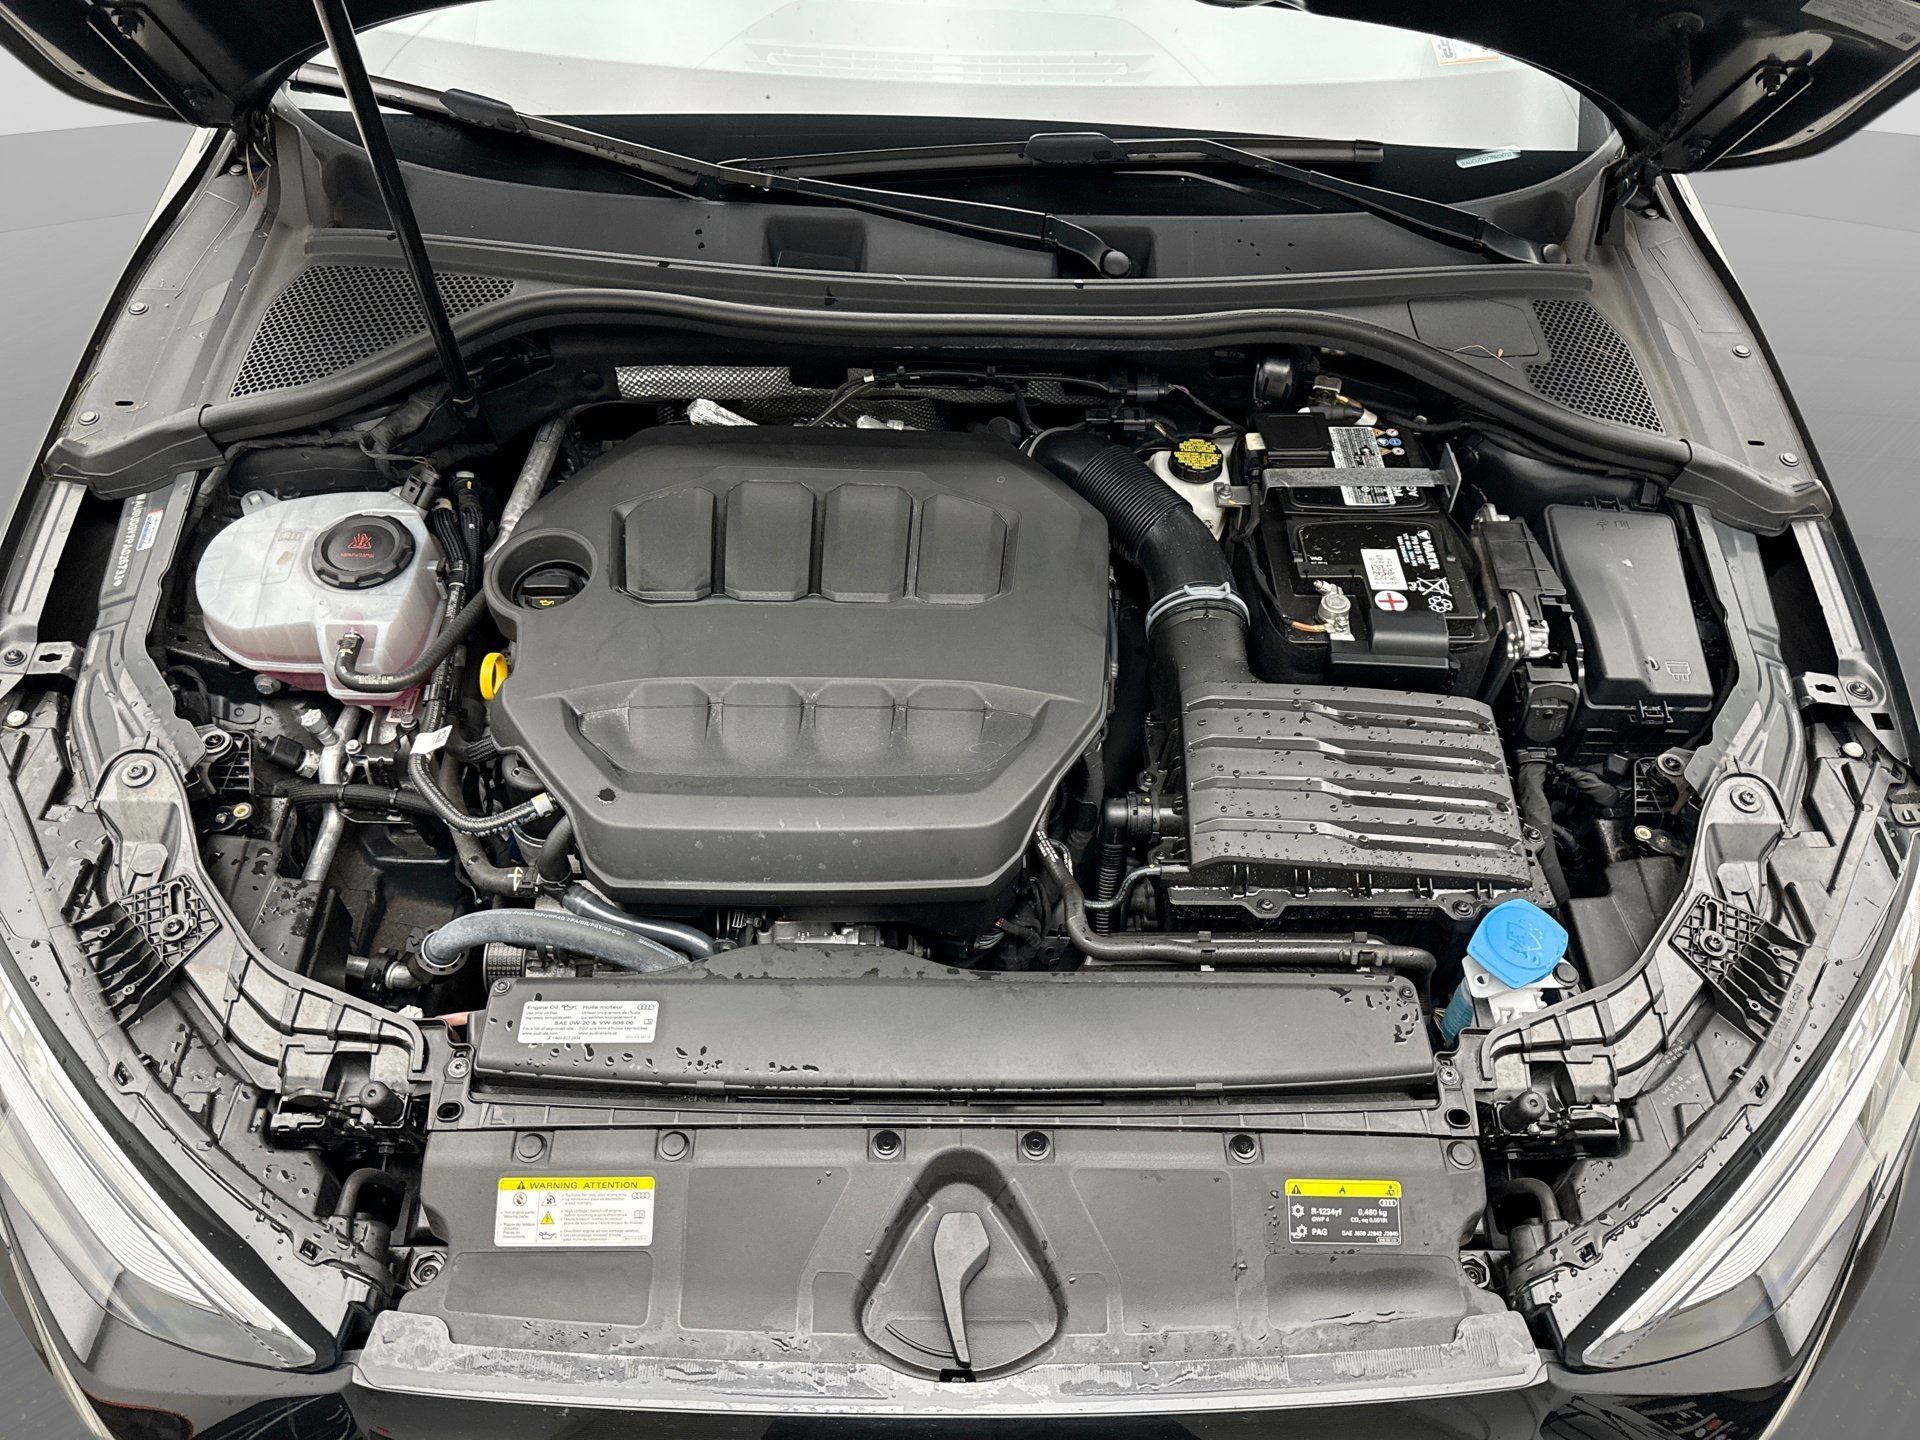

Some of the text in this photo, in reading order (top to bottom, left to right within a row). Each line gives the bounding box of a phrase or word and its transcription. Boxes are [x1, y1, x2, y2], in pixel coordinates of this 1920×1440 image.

[1421, 539, 1439, 569] VARTA
[529, 1181, 578, 1189] WARNING
[1311, 1207, 1342, 1217] R-1234yf
[1378, 1208, 1387, 1217] kg
